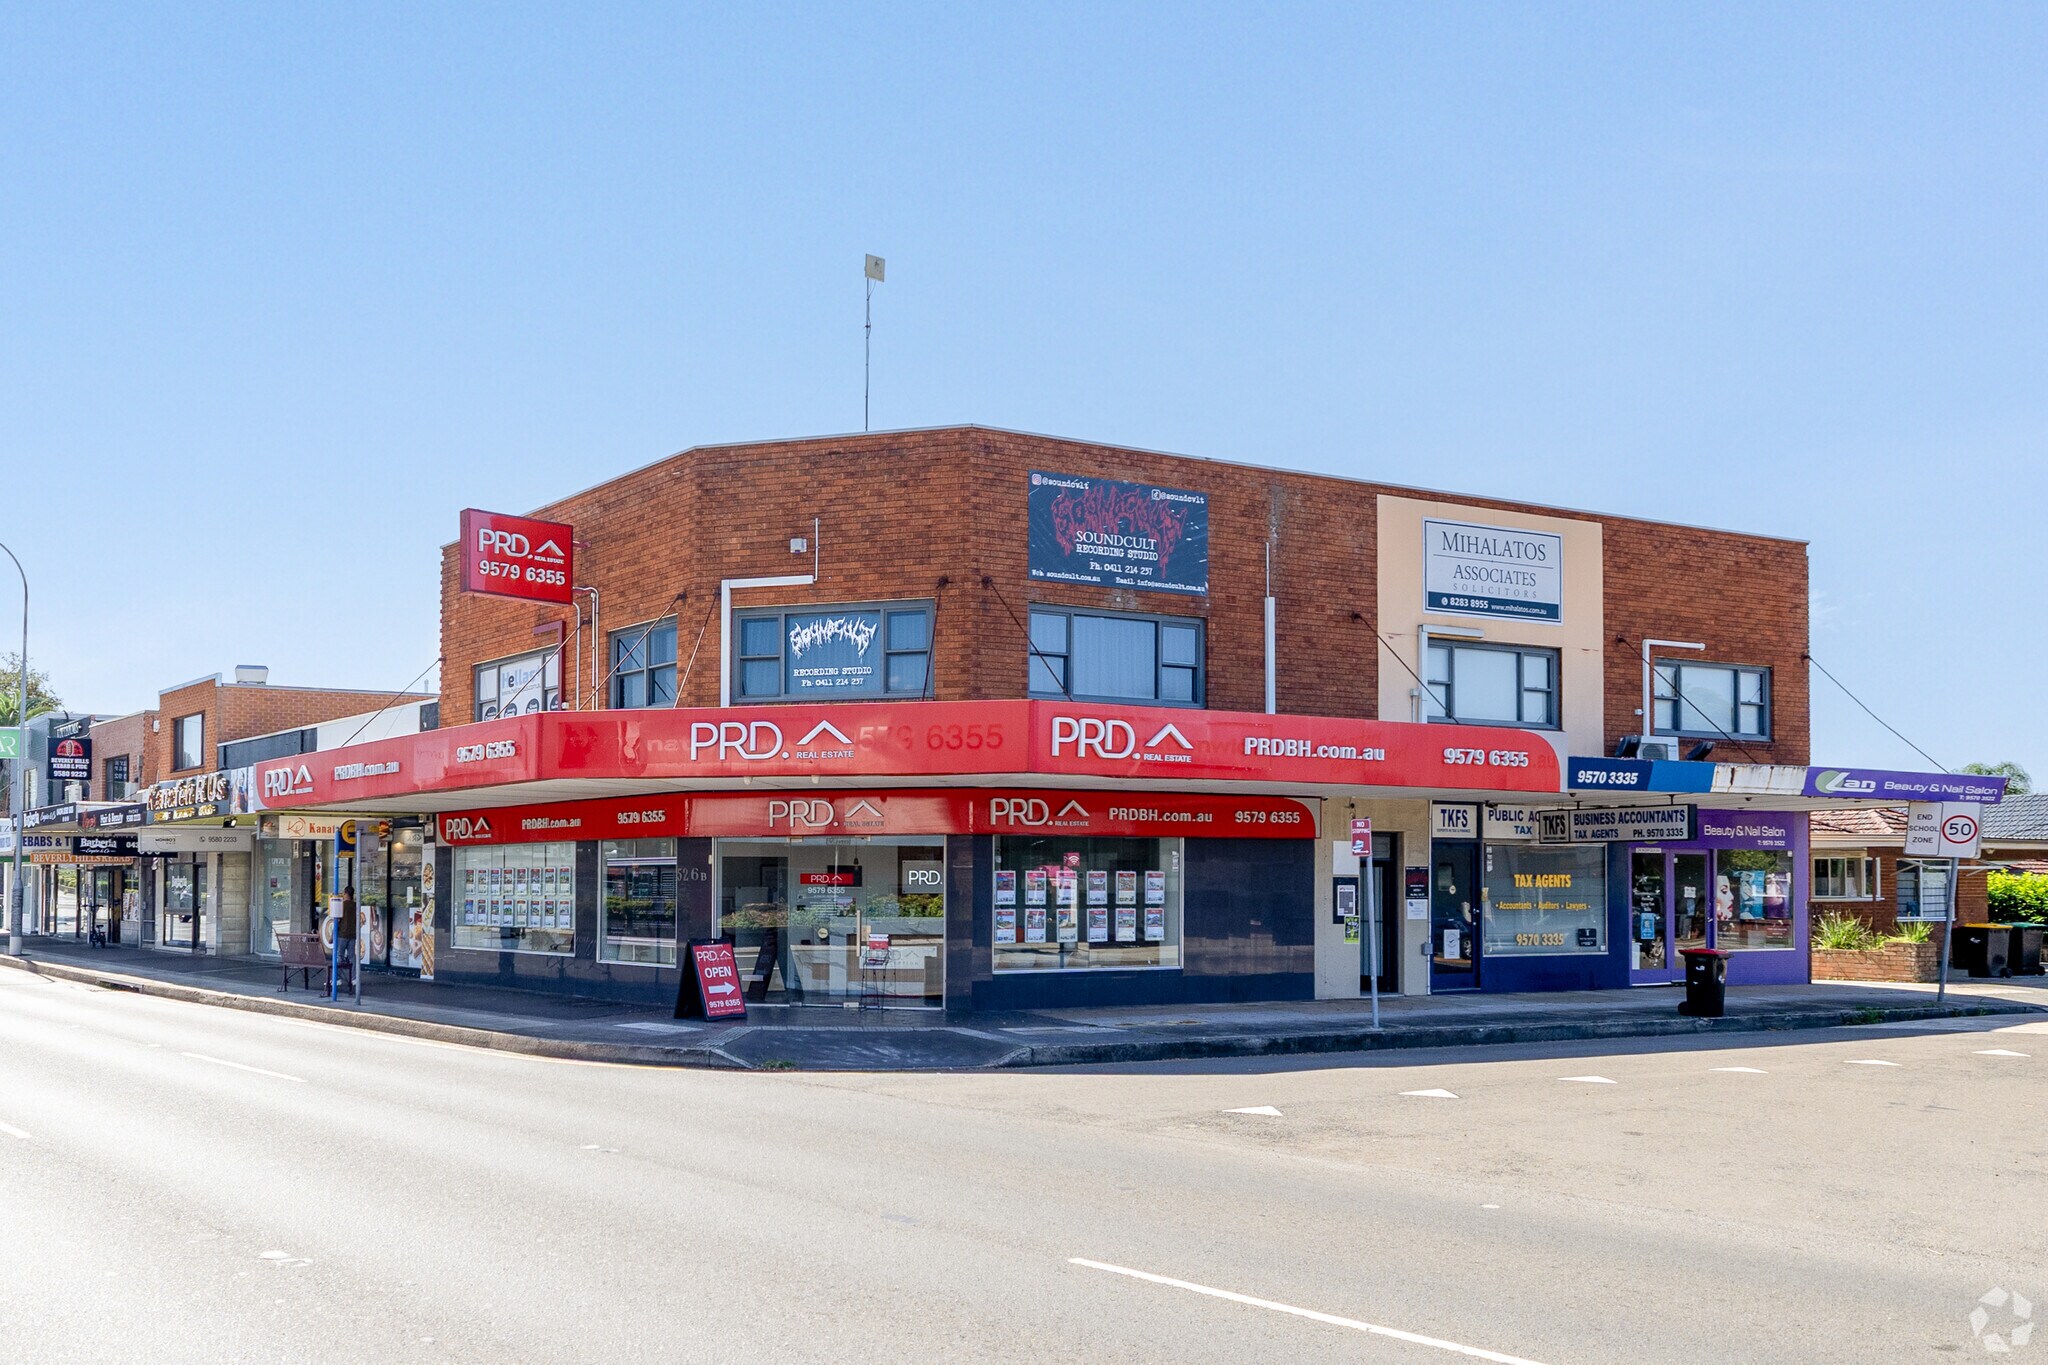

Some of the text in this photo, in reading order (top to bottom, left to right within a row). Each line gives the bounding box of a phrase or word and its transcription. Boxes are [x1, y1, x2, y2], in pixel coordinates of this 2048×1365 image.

[1075, 530, 1157, 551] SOUNDCULT
[1076, 544, 1159, 561] RECORDING STUDIO
[479, 560, 566, 585] 9579 6355
[1104, 563, 1122, 573] 0411
[1124, 565, 1139, 575] 214
[1453, 564, 1537, 587] ASSOCIATES
[1453, 582, 1537, 599] SOLICITORS
[1449, 597, 1547, 615] 8283 8955 www.mihalatos.com.au
[793, 666, 873, 677] RECORDING STUDIO
[816, 678, 833, 686] 0411
[456, 740, 516, 763] 9579 6355
[796, 751, 854, 760] REAL ESTATE
[1244, 736, 1385, 762] PRDBH.com.au
[1144, 753, 1192, 763] REAL ESTATE
[1443, 748, 1485, 765] 9579
[1489, 750, 1529, 768] 6355
[334, 761, 401, 781] PRDBH.com.au
[1577, 770, 1639, 785] 9570 3335
[1884, 781, 1929, 794] Beauty
[1929, 783, 1940, 792] &
[1941, 784, 1964, 794] Nail
[1965, 785, 1998, 795] Salon
[617, 809, 666, 825] 9579 6355
[1109, 807, 1213, 823] PRDBH.com.au
[1235, 811, 1300, 824] 9579 6355
[1440, 808, 1468, 828] TKFS
[1488, 809, 1524, 822] PUBLIC
[1574, 809, 1686, 826] BUSINESS ACCOUNTANTS
[1917, 813, 1933, 821] END
[521, 818, 581, 830] PRDBH.com.au
[1514, 826, 1533, 835] TAX
[1543, 814, 1566, 836] TKFS
[1948, 823, 1972, 836] 50
[1574, 830, 1587, 839] TAX
[1591, 828, 1619, 838] AGENTS
[1633, 828, 1684, 838] PH. 9570 3335
[1704, 824, 1785, 838] Beauty & Nail Salon
[22, 836, 53, 847] EBABS
[55, 837, 62, 847] &
[80, 838, 117, 848] Barberia
[1912, 836, 1934, 844] ZONE
[33, 853, 74, 863] BEVERLY
[908, 870, 943, 885] PRD.
[1514, 874, 1572, 888] TAX AGENTS
[1566, 901, 1587, 911] Lawyers
[1516, 933, 1539, 946] 9570
[1542, 933, 1565, 946] 3335
[704, 966, 732, 979] OPEN
[708, 998, 741, 1008] 9579 6355
